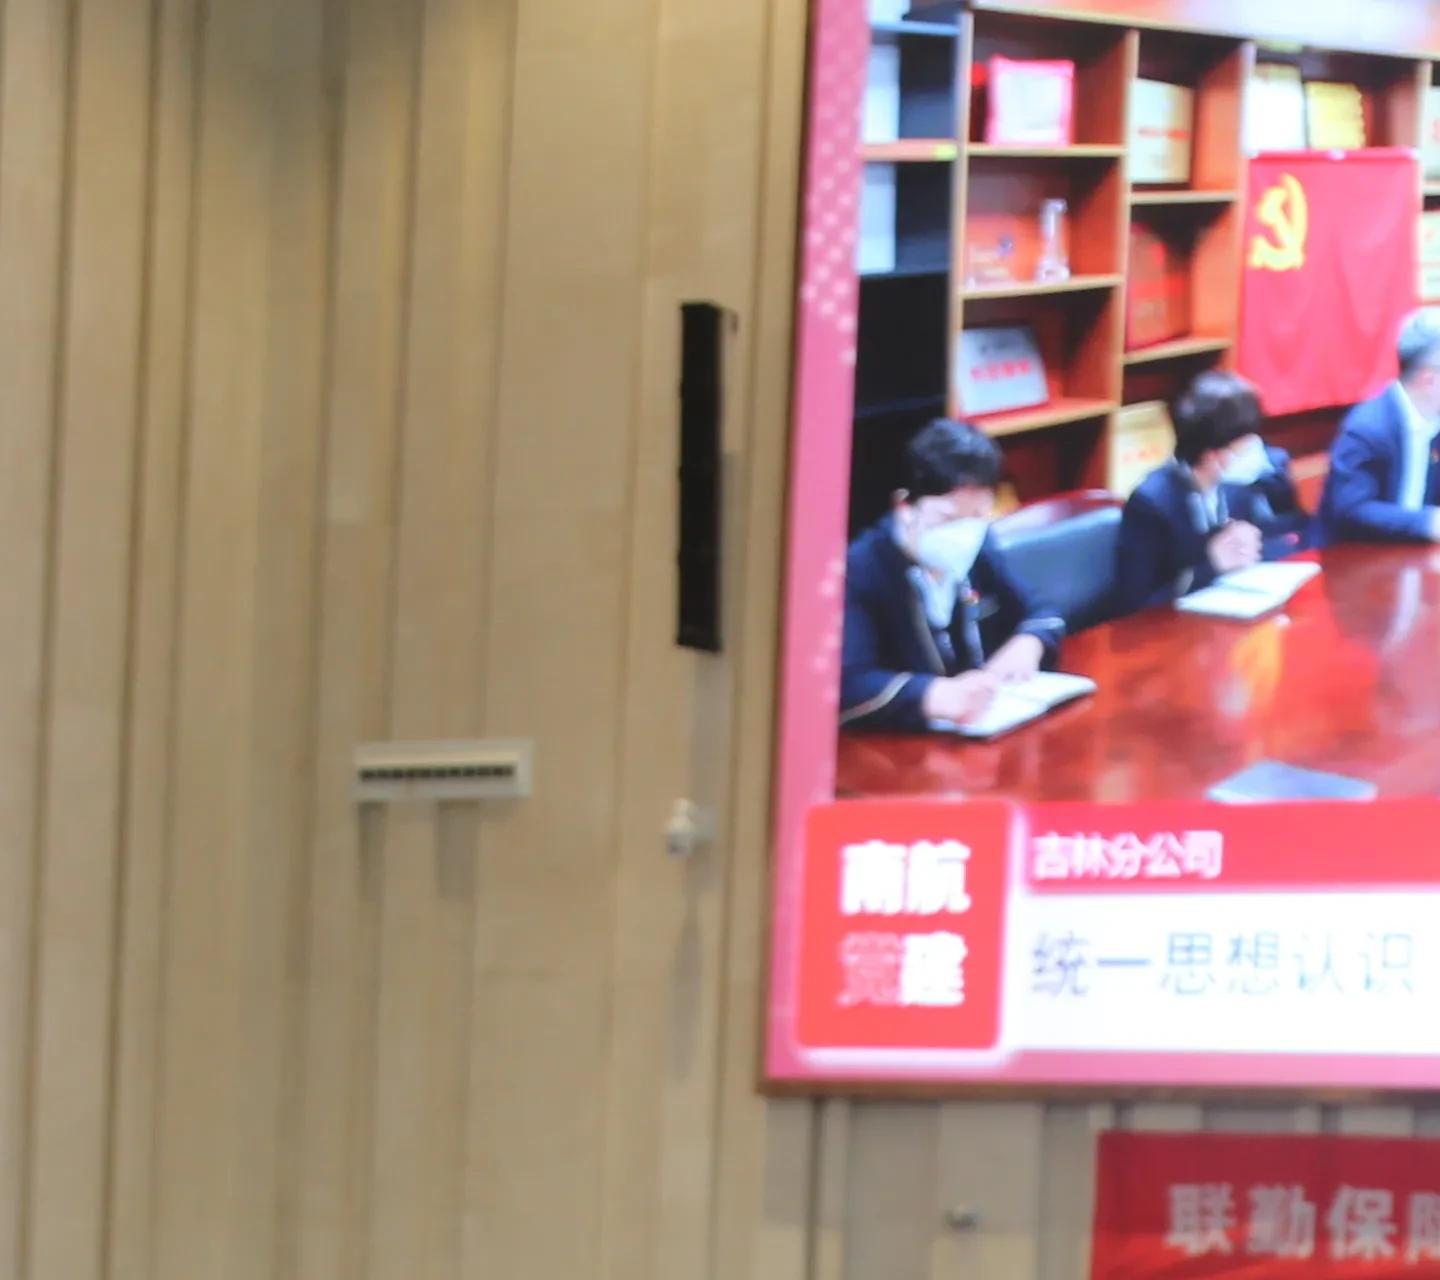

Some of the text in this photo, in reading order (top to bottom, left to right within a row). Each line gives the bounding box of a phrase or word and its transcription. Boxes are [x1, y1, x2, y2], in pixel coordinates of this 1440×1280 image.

[1032, 830, 1223, 880] 吉林分公司
[1031, 931, 1413, 997] 统一思想认识
